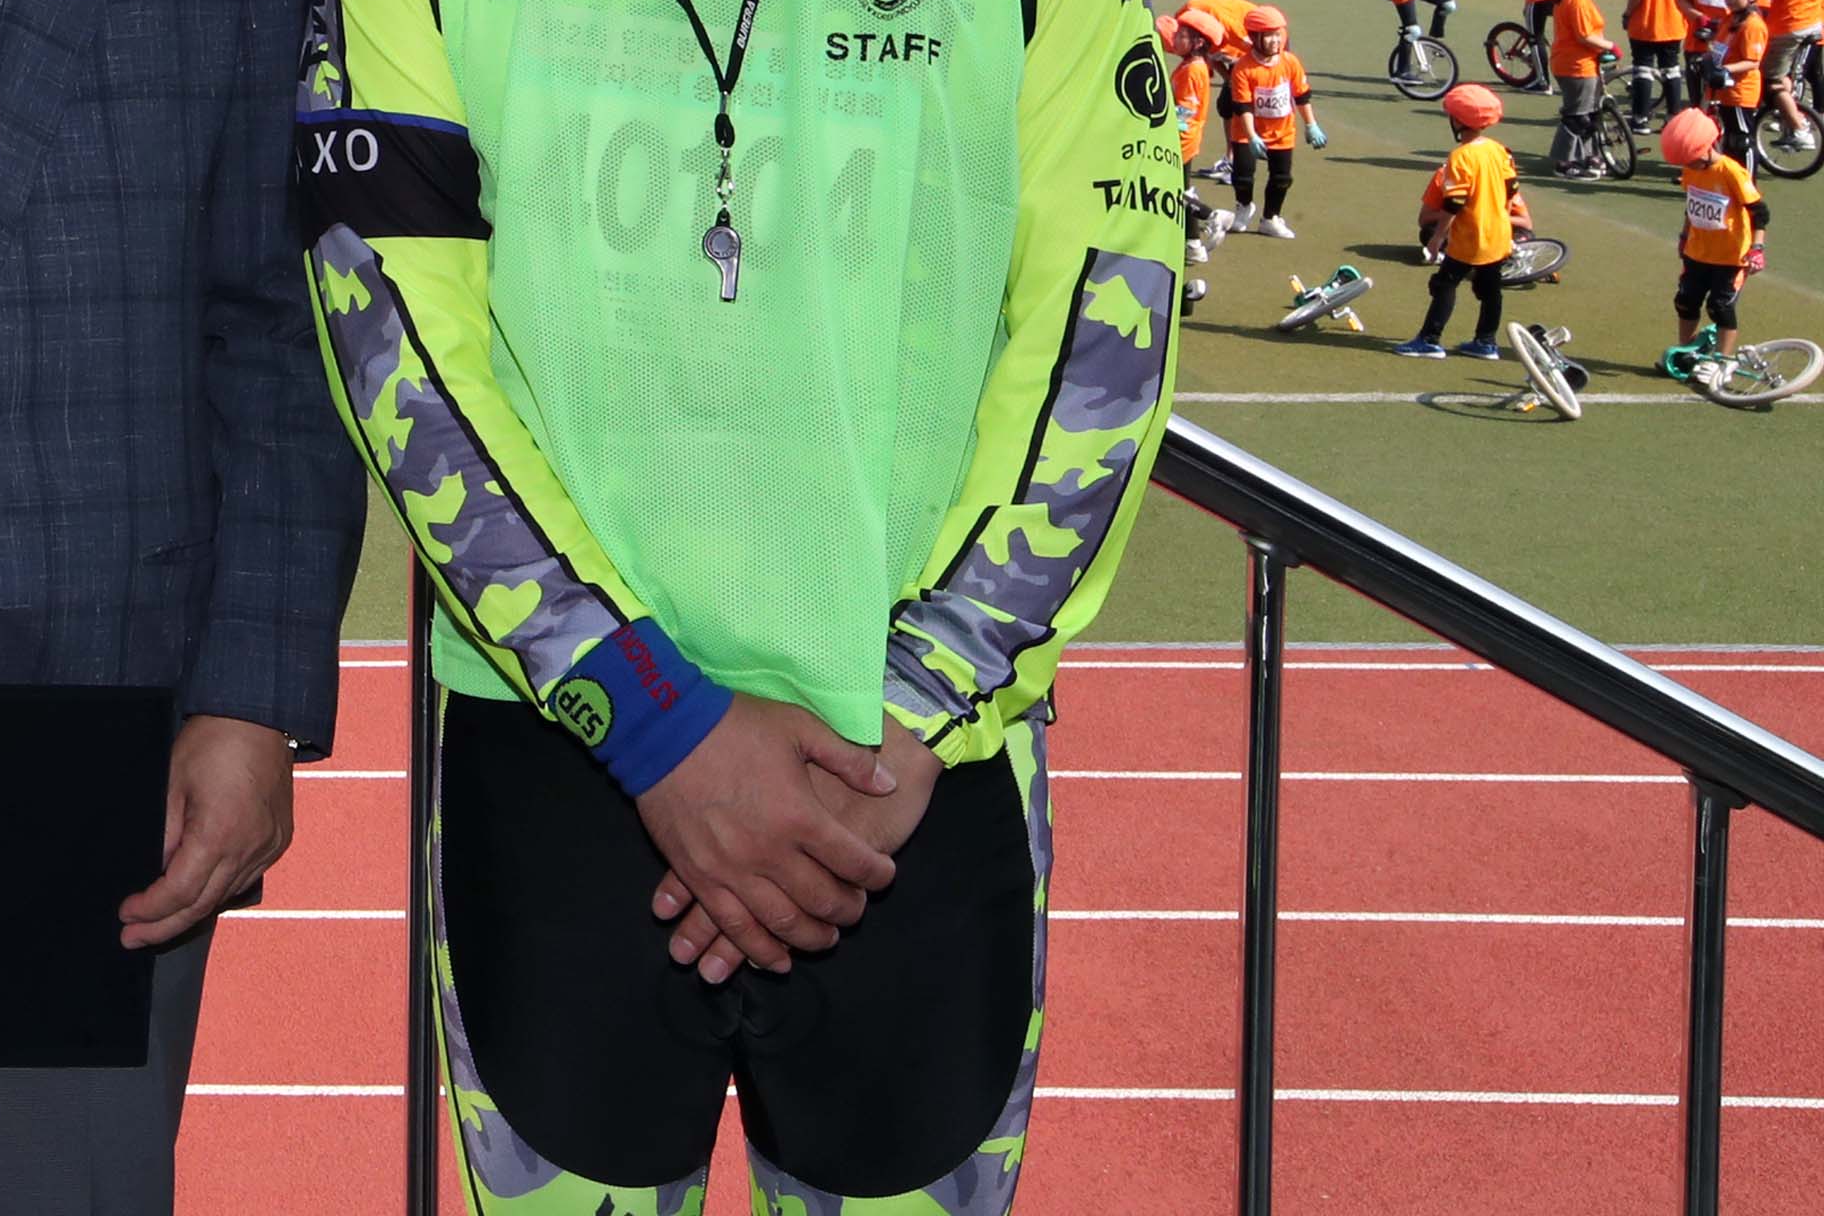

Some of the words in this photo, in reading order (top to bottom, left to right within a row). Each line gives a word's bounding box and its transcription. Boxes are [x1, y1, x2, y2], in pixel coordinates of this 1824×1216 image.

[826, 32, 942, 65] STAFF
[296, 129, 379, 175] XO
[558, 690, 605, 739] SJP
